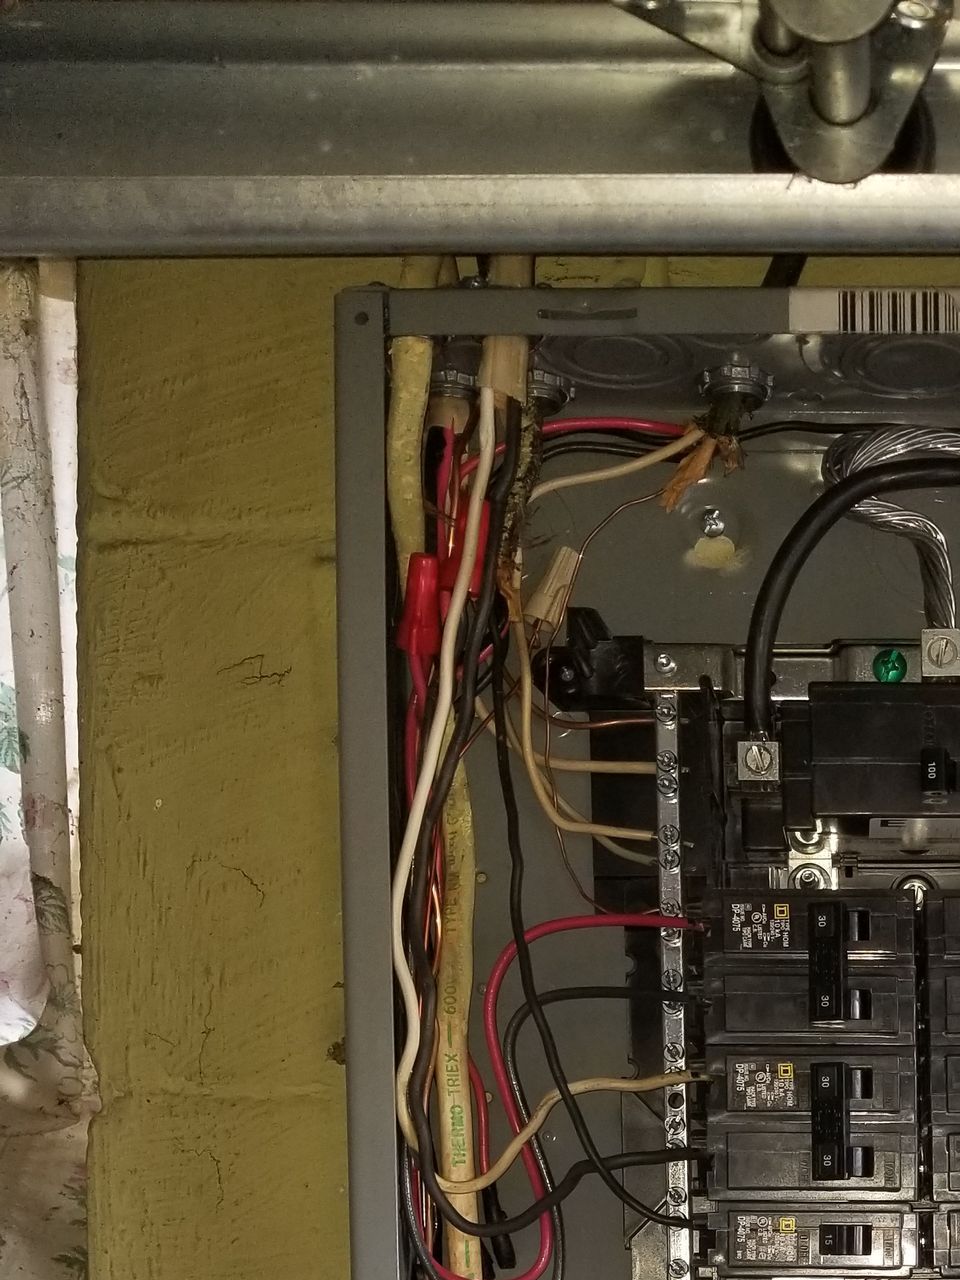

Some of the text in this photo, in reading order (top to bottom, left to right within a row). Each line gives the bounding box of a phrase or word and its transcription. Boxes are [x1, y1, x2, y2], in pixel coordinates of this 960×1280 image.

[927, 761, 937, 779] 100
[731, 903, 740, 931] DP-4075
[818, 915, 827, 928] 30
[821, 995, 830, 1008] 30
[446, 1053, 461, 1097] TRIEX
[821, 1076, 830, 1088] 30
[452, 1104, 467, 1168] THERMO
[823, 1154, 832, 1167] 30
[737, 1215, 746, 1243] DP-4075
[825, 1234, 833, 1246] 15
